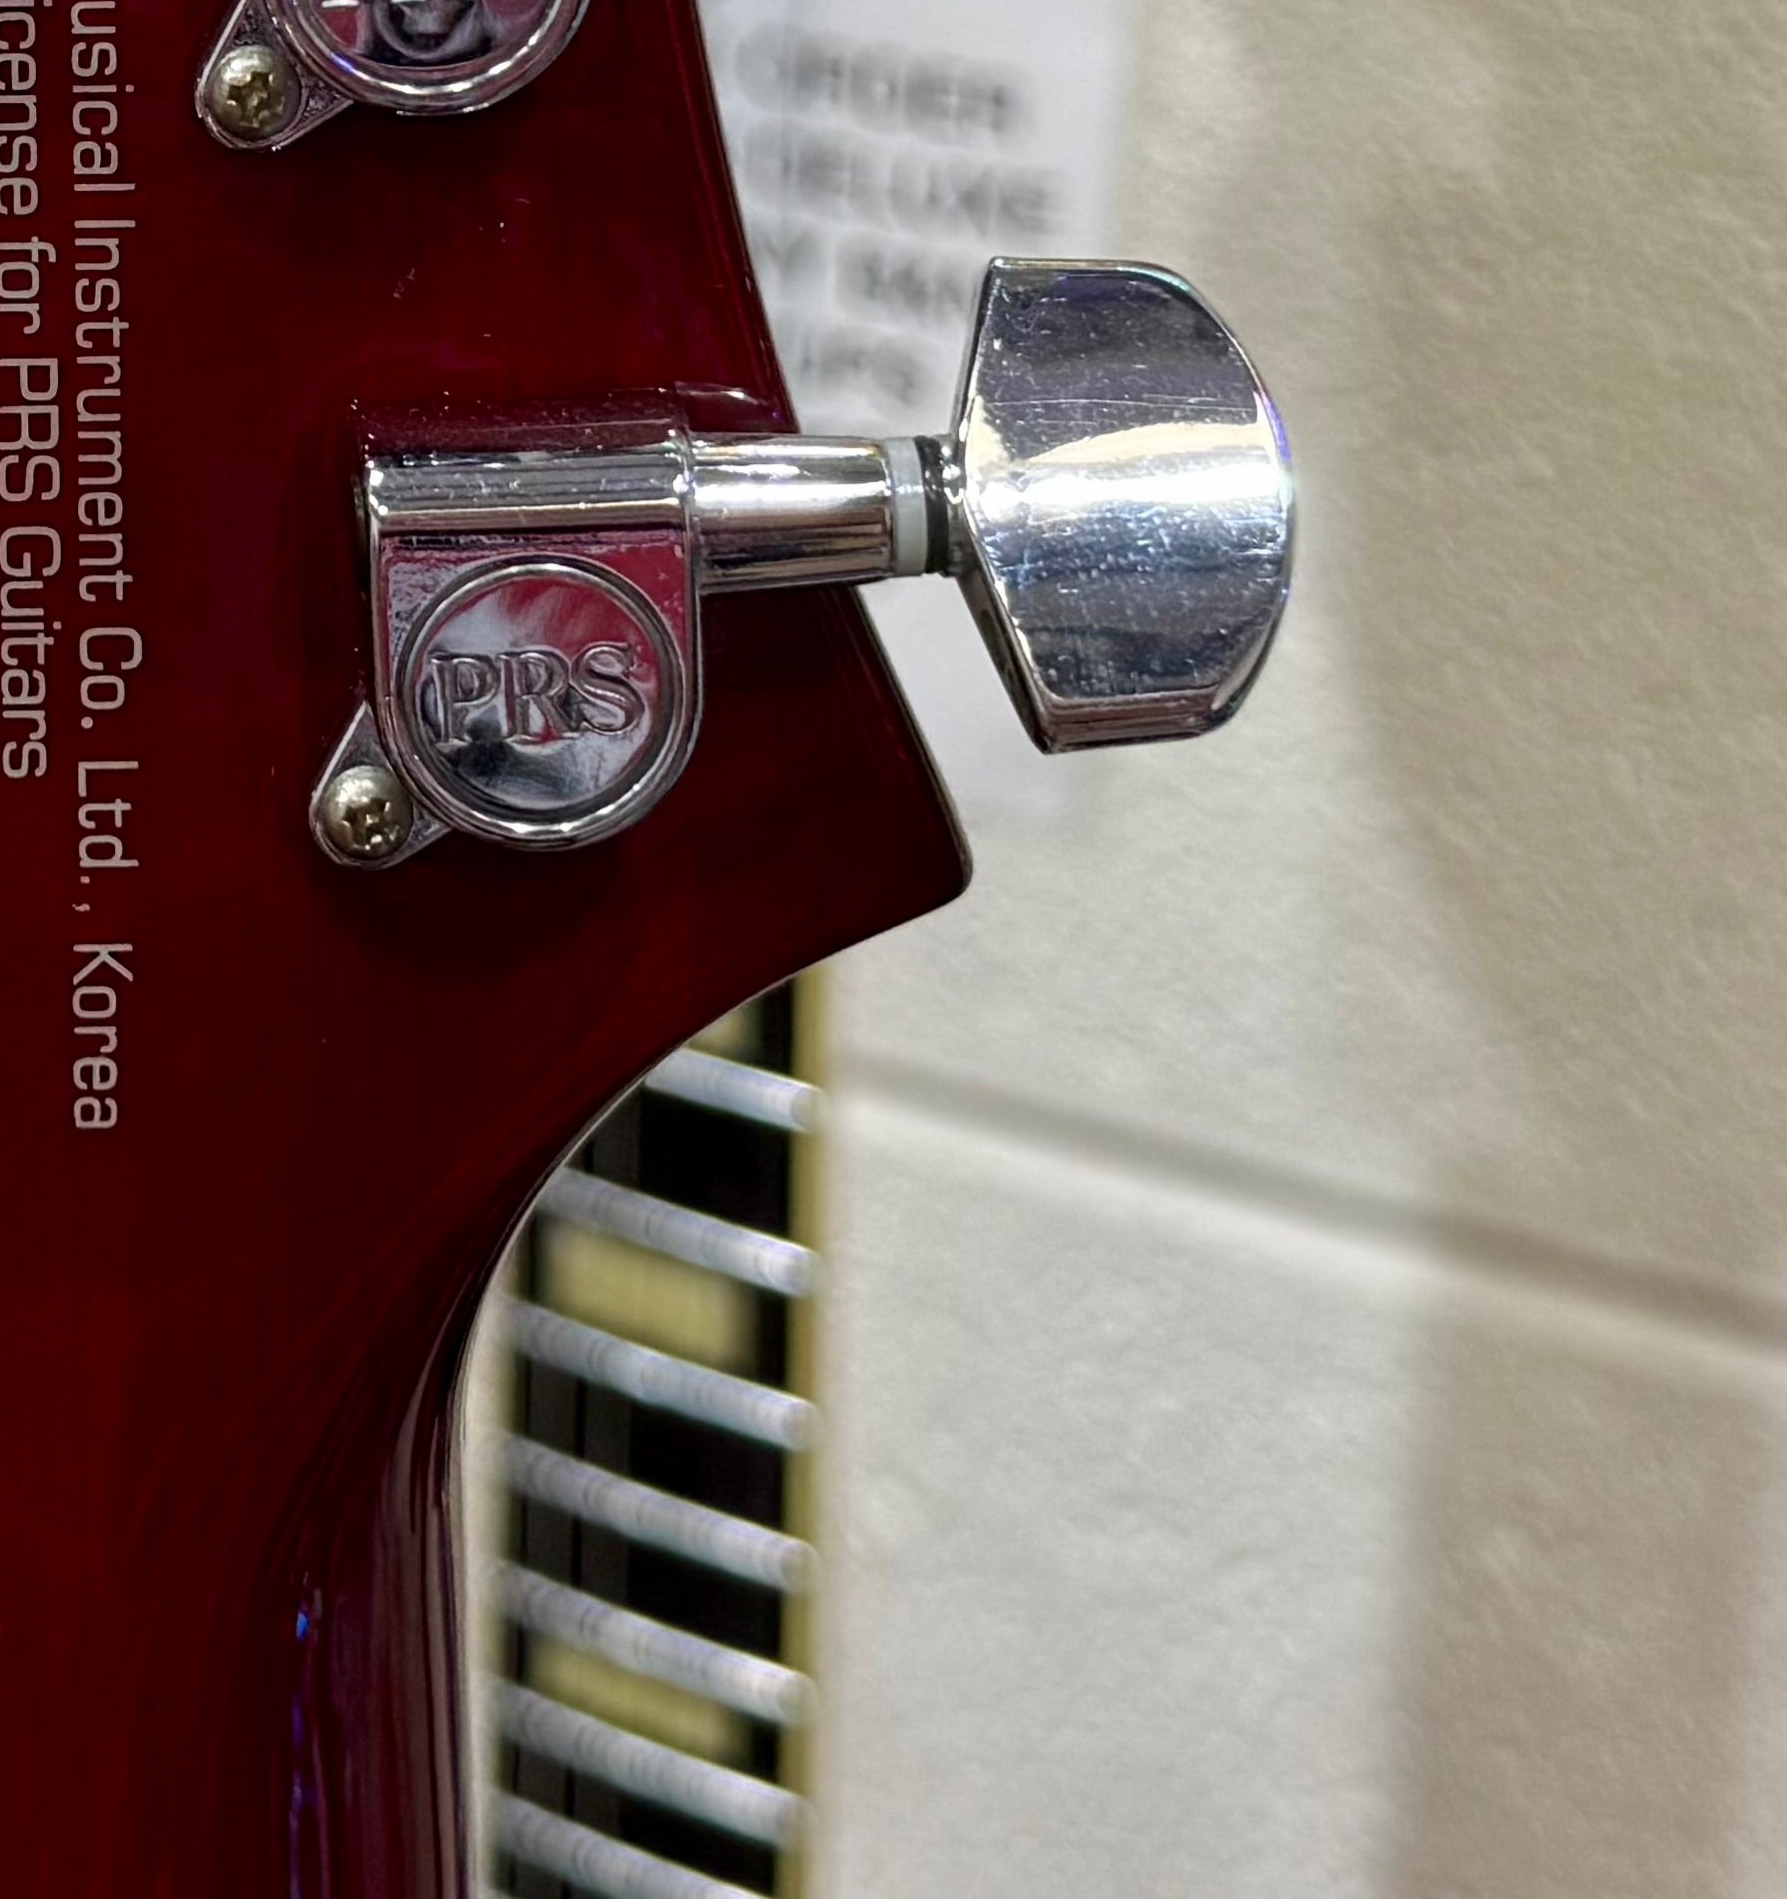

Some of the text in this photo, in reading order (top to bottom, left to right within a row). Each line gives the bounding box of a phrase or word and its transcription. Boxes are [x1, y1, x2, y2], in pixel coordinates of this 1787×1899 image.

[74, 220, 135, 601] Instrument
[0, 526, 61, 778] Guitars
[80, 627, 142, 729] Co.
[424, 637, 649, 752] PRS
[73, 944, 133, 1128] Korea
